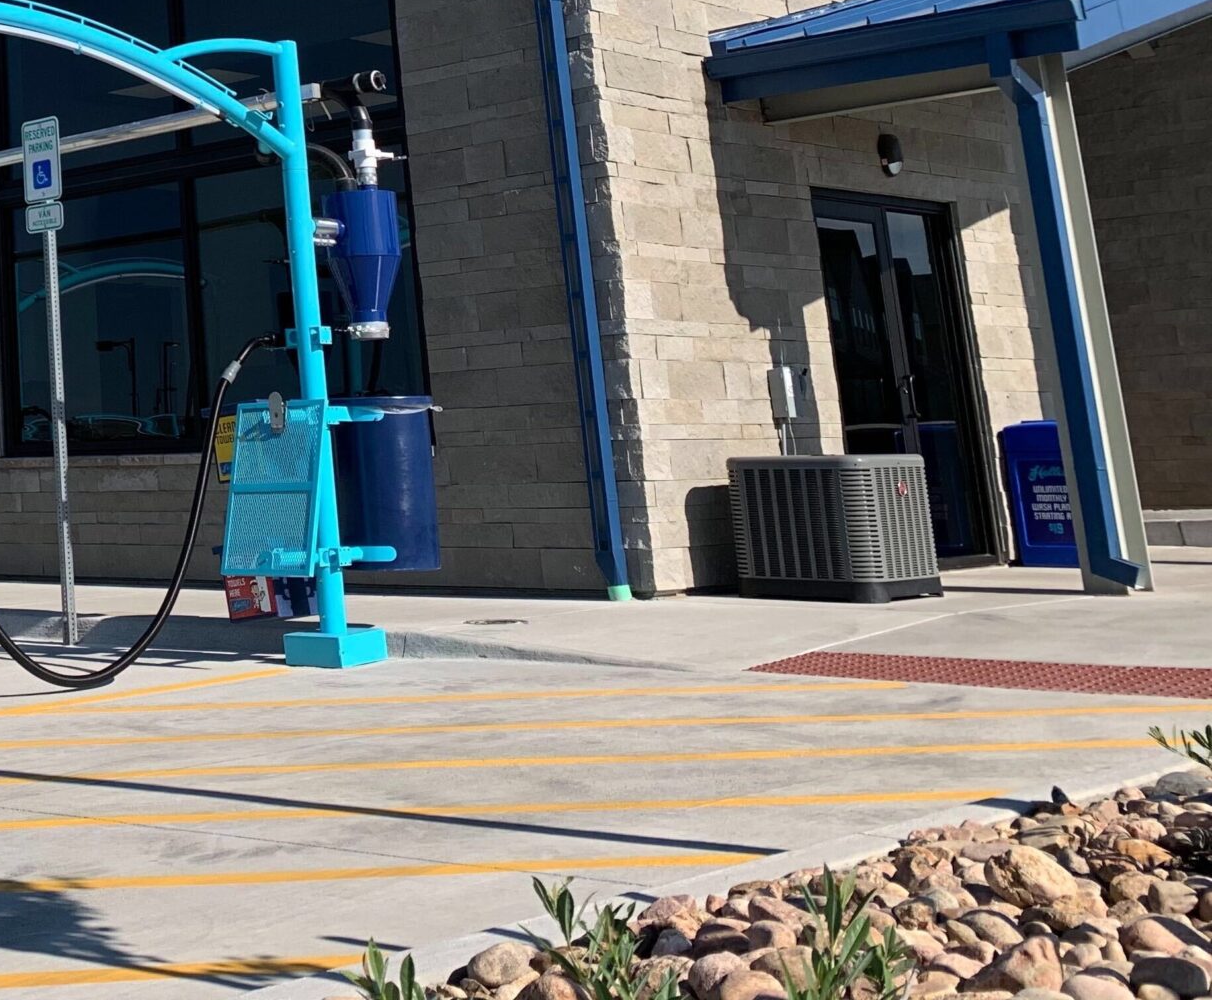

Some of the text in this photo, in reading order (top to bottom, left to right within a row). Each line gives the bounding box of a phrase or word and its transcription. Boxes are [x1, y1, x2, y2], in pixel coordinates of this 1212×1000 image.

[24, 126, 55, 140] RESERVED
[28, 140, 53, 154] PARKING
[38, 209, 51, 219] VAN
[1028, 465, 1065, 481] Hell
[1032, 485, 1068, 493] UNLIMITED
[1036, 494, 1067, 502] MONTHLY
[1031, 503, 1071, 511] WASH PLAN
[1034, 512, 1065, 520] STARTING
